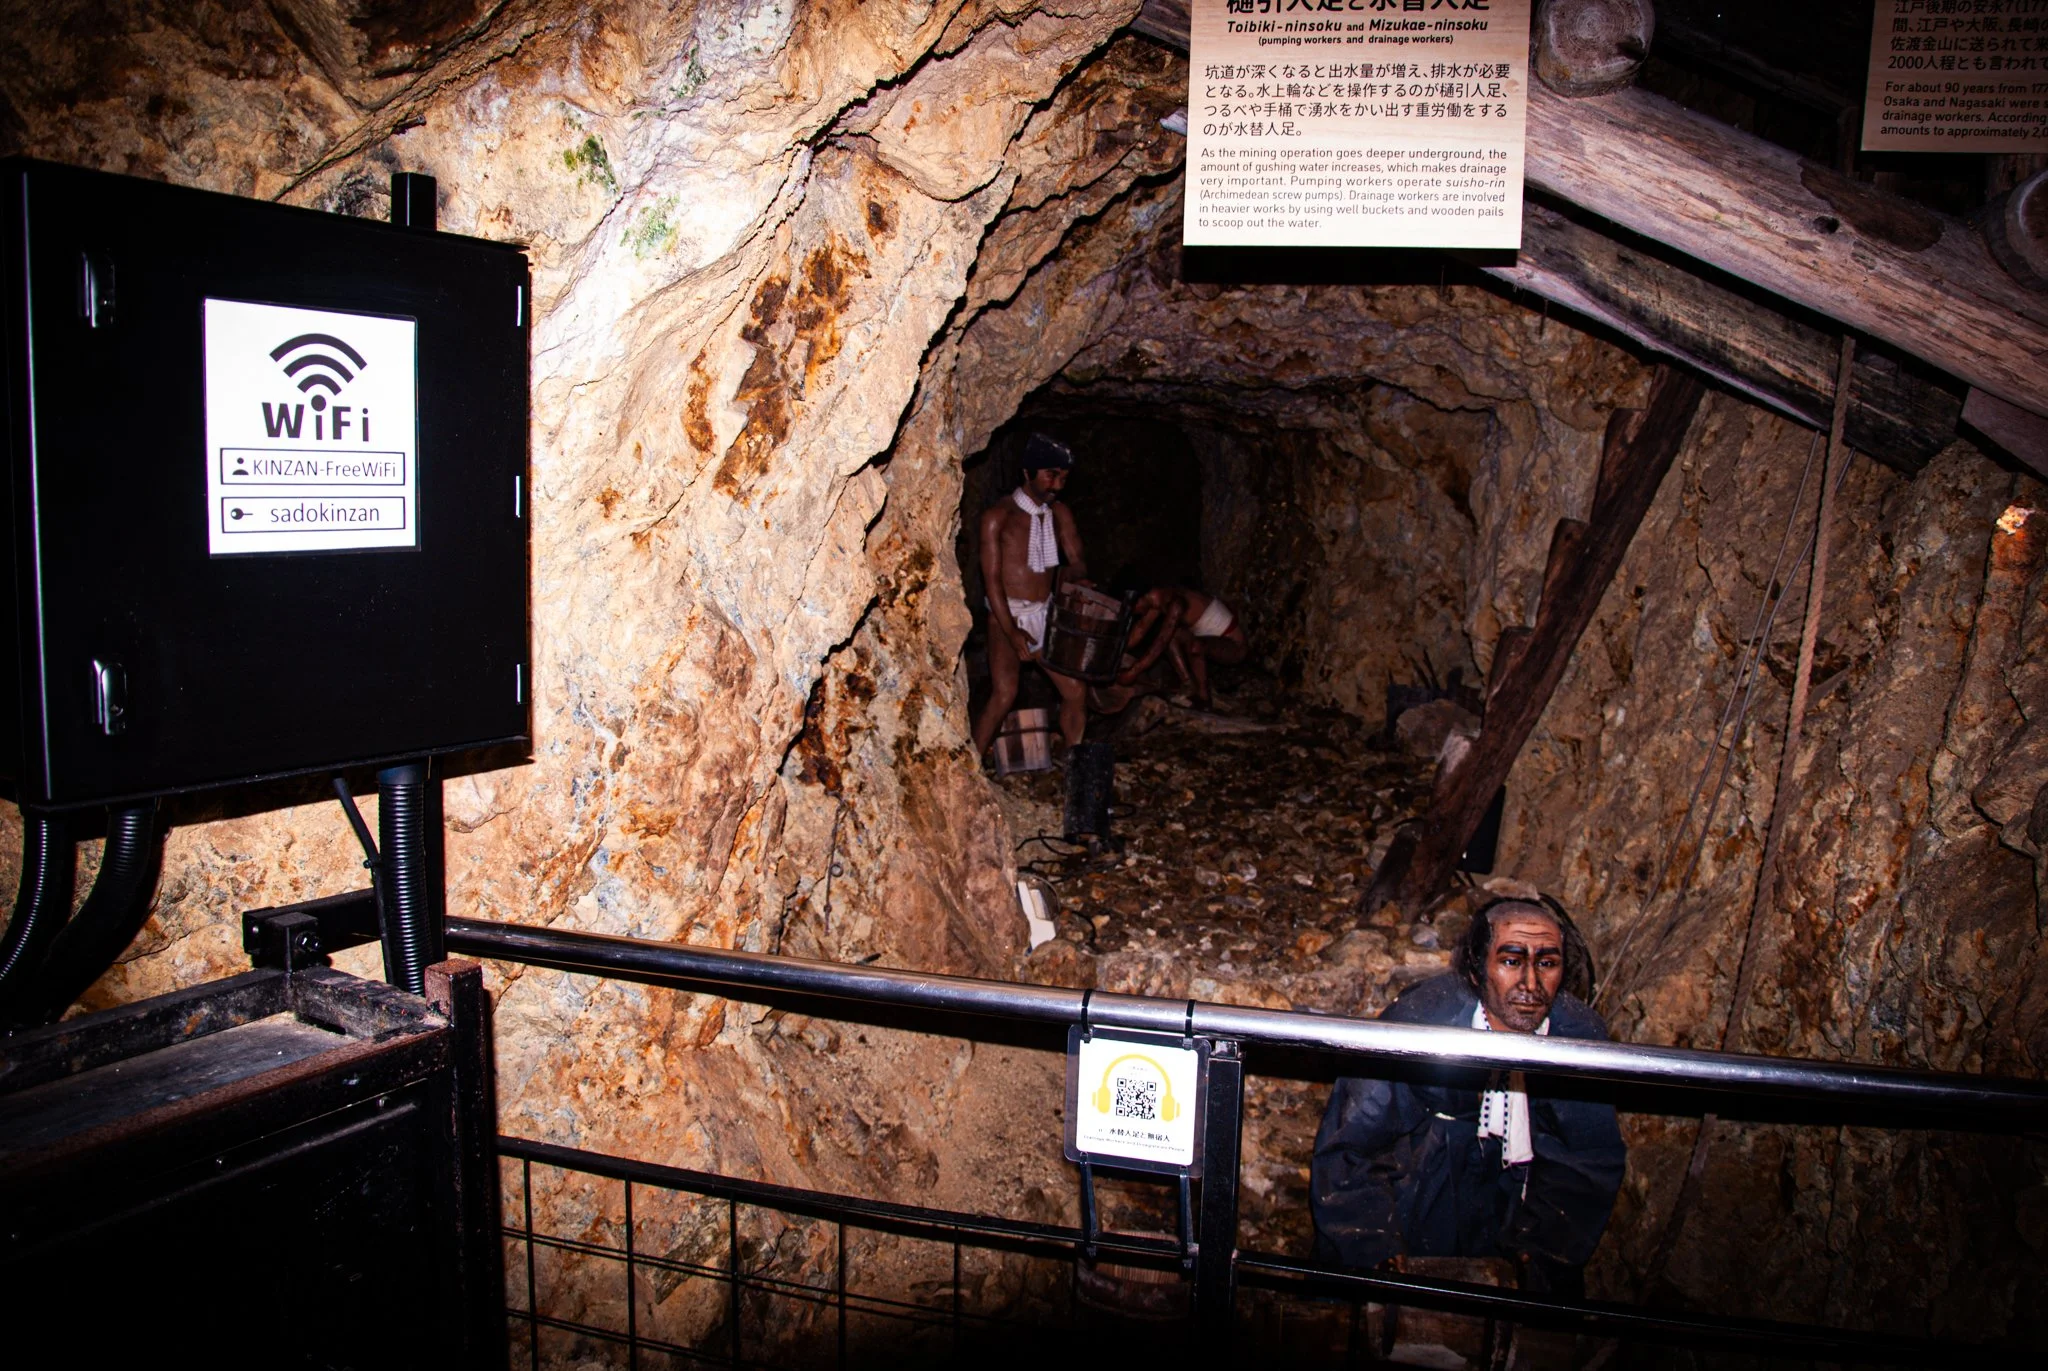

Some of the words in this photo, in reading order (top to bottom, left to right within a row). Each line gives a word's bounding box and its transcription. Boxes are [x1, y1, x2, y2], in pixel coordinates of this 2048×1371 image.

[1227, 20, 1342, 33] Toibiki-ninsoku
[1347, 22, 1364, 32] and
[1369, 19, 1488, 31] Mizukae-ninsoku
[1258, 35, 1301, 46] (pumping
[1304, 35, 1341, 44] workers
[1346, 34, 1364, 44] and
[1368, 34, 1409, 45] drainage
[1412, 33, 1454, 45] workers)
[1205, 63, 1510, 80] 坑道が深くなると出水量が増え、排水が必要
[1886, 81, 1905, 92] For
[1908, 82, 1941, 92] about
[1944, 83, 1959, 93] 90
[1963, 84, 1994, 95] years
[1999, 84, 2026, 94] from
[1204, 102, 1507, 118] つるべや手桶で湧水をかい出す重労働をする
[1884, 96, 1919, 106] Osaka
[1923, 96, 1945, 107] and
[1951, 97, 2005, 110] Nagasaki
[2009, 99, 2040, 108] were
[1882, 110, 1931, 123] drainage
[1935, 112, 1984, 122] workers.
[1988, 112, 2046, 125] According
[1203, 121, 1302, 137] のが水替人足。
[1881, 126, 1930, 135] amounts
[1934, 127, 1944, 135] to
[1947, 127, 2028, 139] approximately
[1201, 148, 1215, 158] As
[1218, 148, 1236, 158] the
[1239, 148, 1277, 161] mining
[1280, 148, 1333, 161] operation
[1336, 151, 1362, 161] goes
[1366, 149, 1405, 161] deeper
[1408, 149, 1485, 161] underground,
[1488, 149, 1507, 159] the
[1200, 162, 1239, 172] amount
[1242, 162, 1252, 172] of
[1255, 162, 1296, 174] gushing
[1299, 163, 1329, 173] water
[1331, 163, 1384, 174] increases,
[1387, 163, 1418, 173] which
[1421, 163, 1456, 173] makes
[1459, 163, 1506, 175] drainage
[1200, 177, 1224, 188] very
[1227, 176, 1286, 189] important.
[1290, 176, 1342, 189] Pumping
[1346, 176, 1393, 187] workers
[1397, 178, 1442, 189] operate
[1446, 178, 1505, 188] suisho-rin
[1200, 190, 1269, 201] (Archimedean
[1272, 192, 1301, 200] screw
[1305, 191, 1346, 202] pumps).
[1349, 191, 1395, 202] Drainage
[1398, 191, 1439, 201] workers
[1442, 193, 1459, 202] are
[1462, 192, 1505, 202] involved
[1199, 204, 1208, 213] in
[1212, 204, 1250, 214] heavier
[1253, 204, 1285, 214] works
[1288, 204, 1301, 215] by
[1304, 205, 1333, 216] using
[1336, 204, 1359, 214] well
[1362, 205, 1404, 215] buckets
[1408, 205, 1428, 215] and
[1431, 206, 1475, 216] wooden
[1478, 206, 1504, 218] pails
[1199, 218, 1208, 227] to
[1212, 220, 1243, 230] scoop
[1247, 219, 1264, 227] out
[1268, 218, 1284, 227] the
[1288, 219, 1322, 228] water.
[262, 394, 369, 442] WiFi
[253, 459, 396, 478] KINZAN-FreeWiFi
[270, 502, 379, 522] sadokinzan
